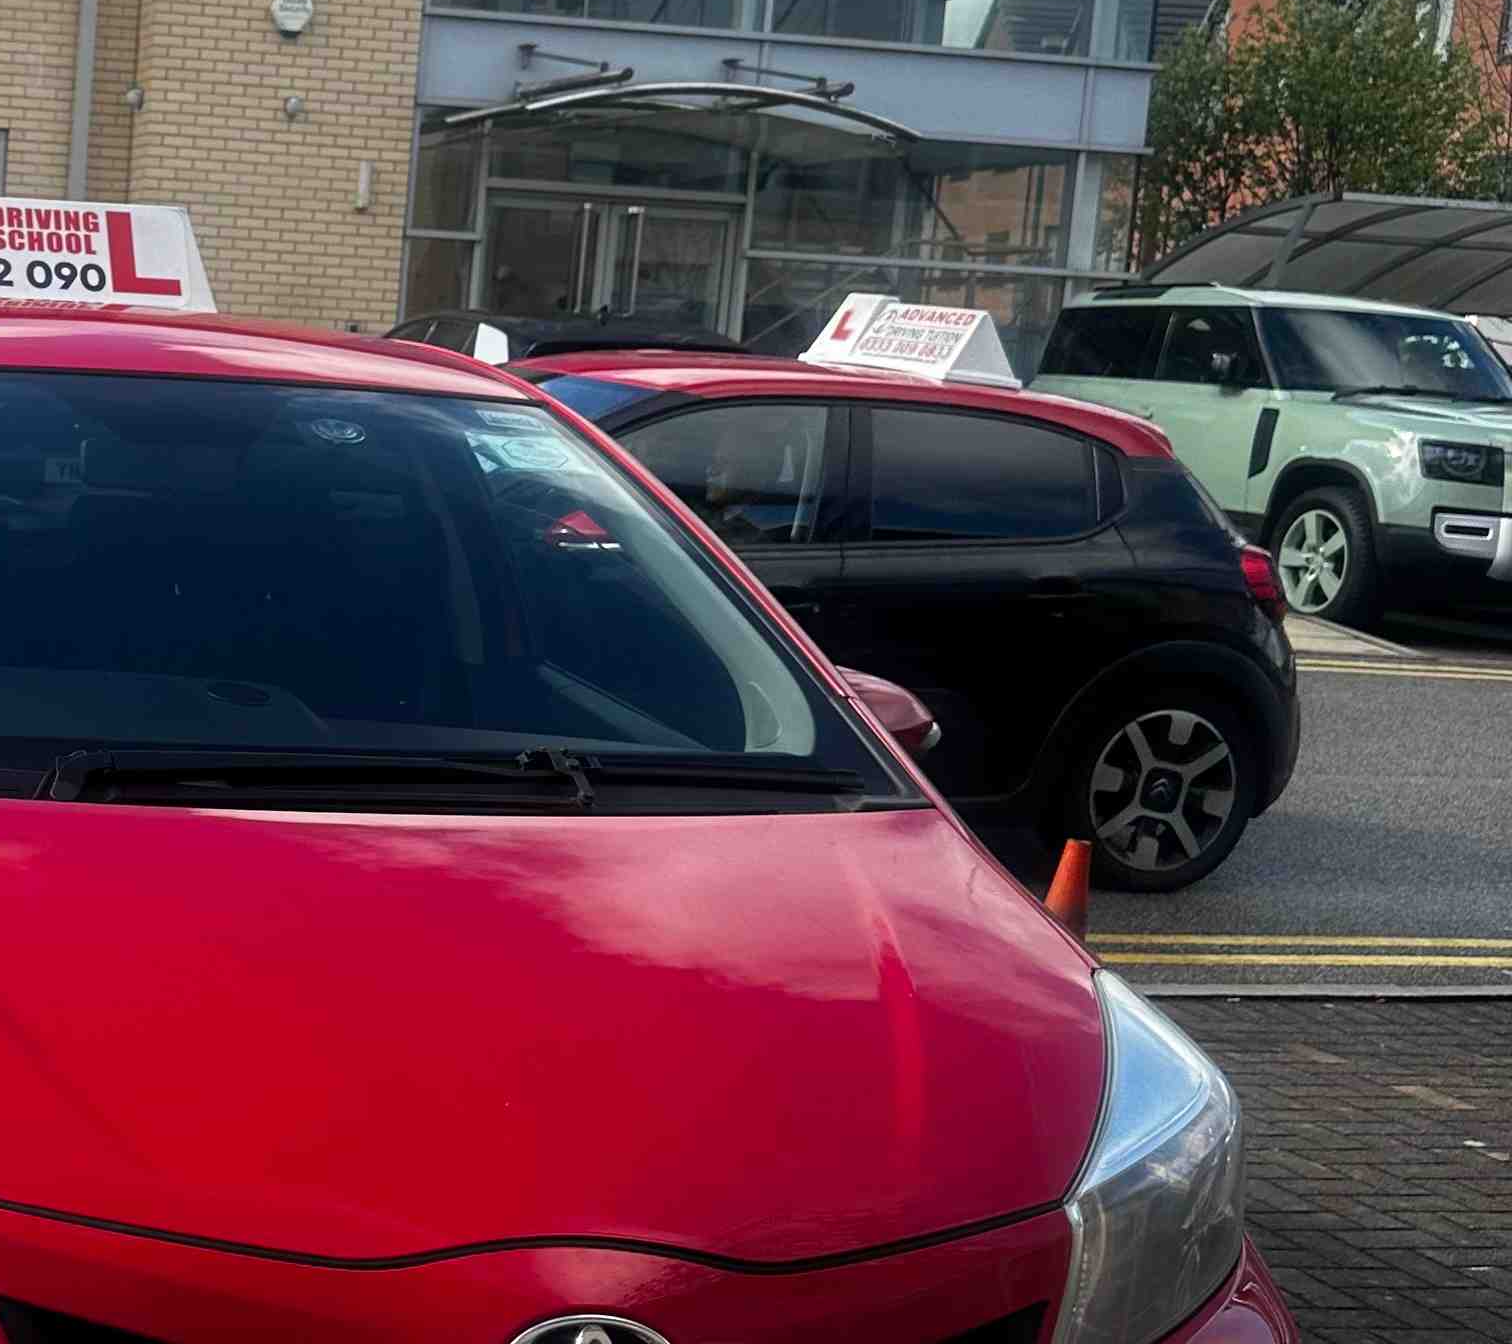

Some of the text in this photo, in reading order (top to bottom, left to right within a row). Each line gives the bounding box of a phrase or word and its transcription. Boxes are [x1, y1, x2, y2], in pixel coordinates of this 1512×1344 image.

[105, 210, 182, 297] L
[26, 260, 106, 292] 090
[830, 310, 854, 341] L
[897, 307, 977, 326] ADVANCED
